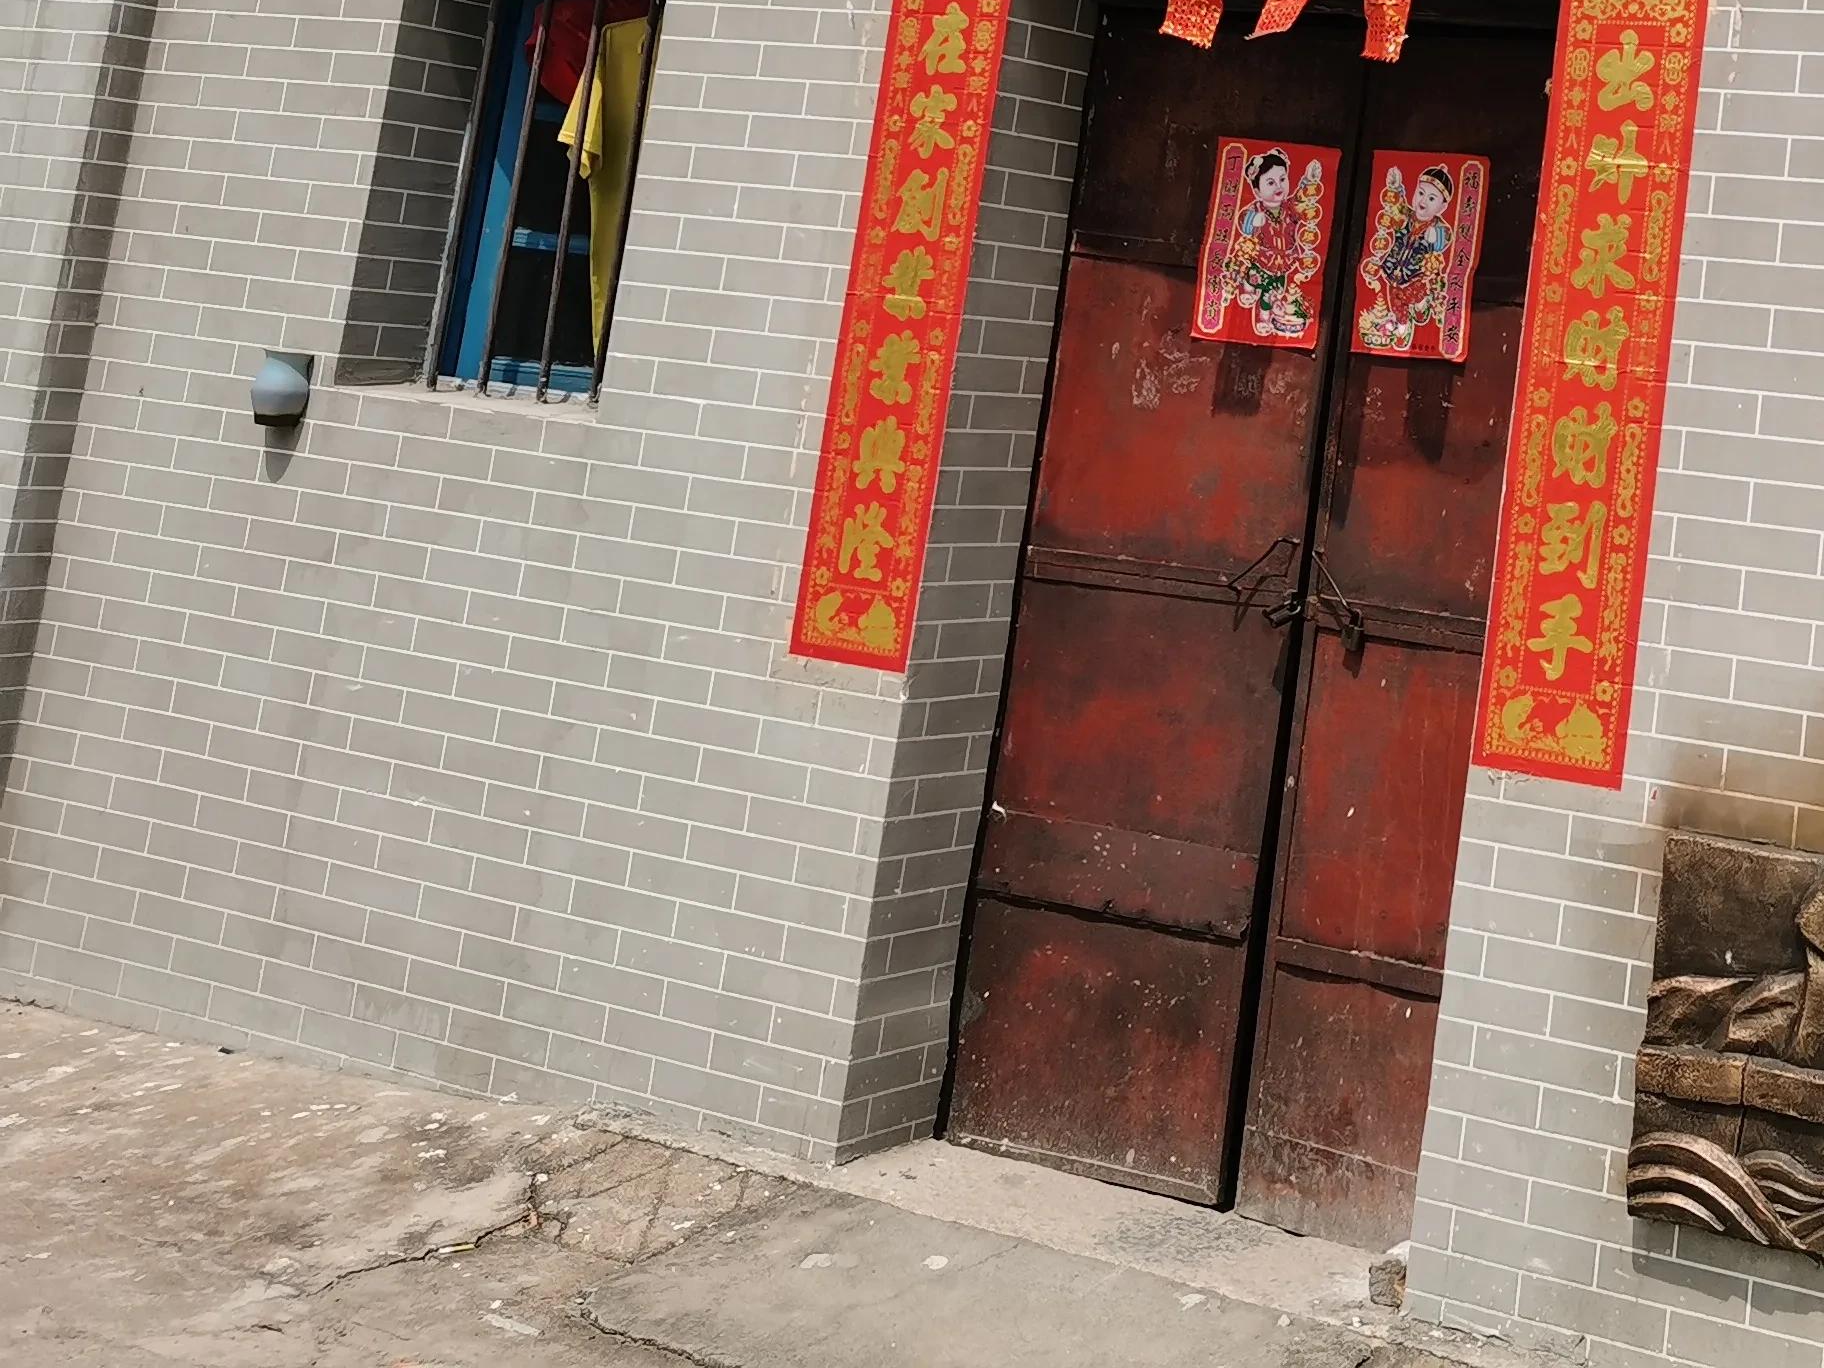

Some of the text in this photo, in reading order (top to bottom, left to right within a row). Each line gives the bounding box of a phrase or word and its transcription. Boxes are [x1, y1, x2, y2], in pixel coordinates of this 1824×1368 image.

[1526, 28, 1656, 681] 出外求財財到手
